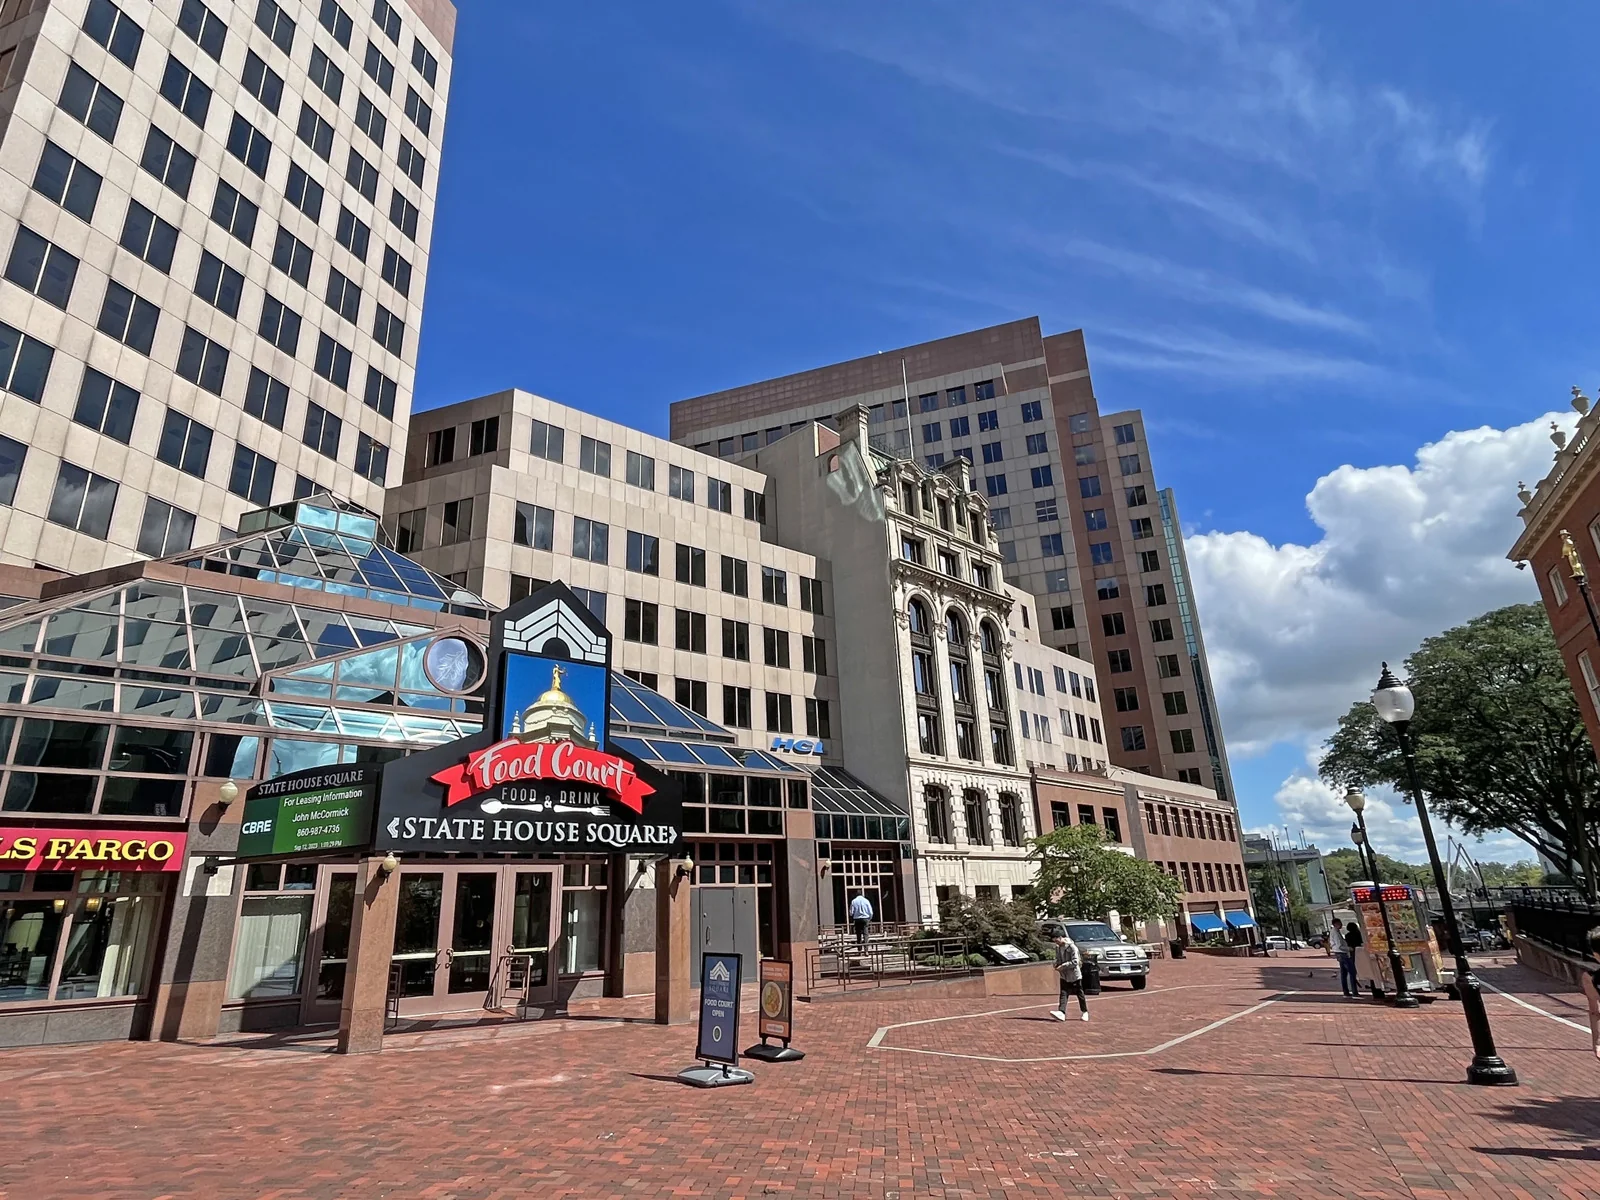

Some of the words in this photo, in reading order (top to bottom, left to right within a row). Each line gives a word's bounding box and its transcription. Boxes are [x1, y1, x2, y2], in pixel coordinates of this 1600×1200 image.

[467, 738, 544, 789] Food
[551, 741, 635, 793] Court
[258, 781, 286, 796] STATE
[288, 776, 322, 792] HOUSE
[323, 769, 364, 787] SQUARE
[283, 797, 296, 807] For
[295, 794, 322, 806] Leasing
[322, 788, 363, 802] Information
[501, 786, 537, 802] FOOD
[544, 794, 552, 809] &
[560, 790, 600, 805] DRINK
[292, 812, 310, 823] John
[310, 806, 350, 820] McCormick
[242, 819, 273, 834] CBRE
[296, 824, 341, 838] 860-987-4736
[402, 816, 485, 840] STATE
[491, 819, 580, 843] HOUSE
[586, 822, 670, 847] SQUARE
[45, 838, 175, 861] FARGO
[704, 998, 717, 1007] FOOD
[717, 1000, 734, 1009] COURT
[711, 1009, 725, 1018] OPEN
